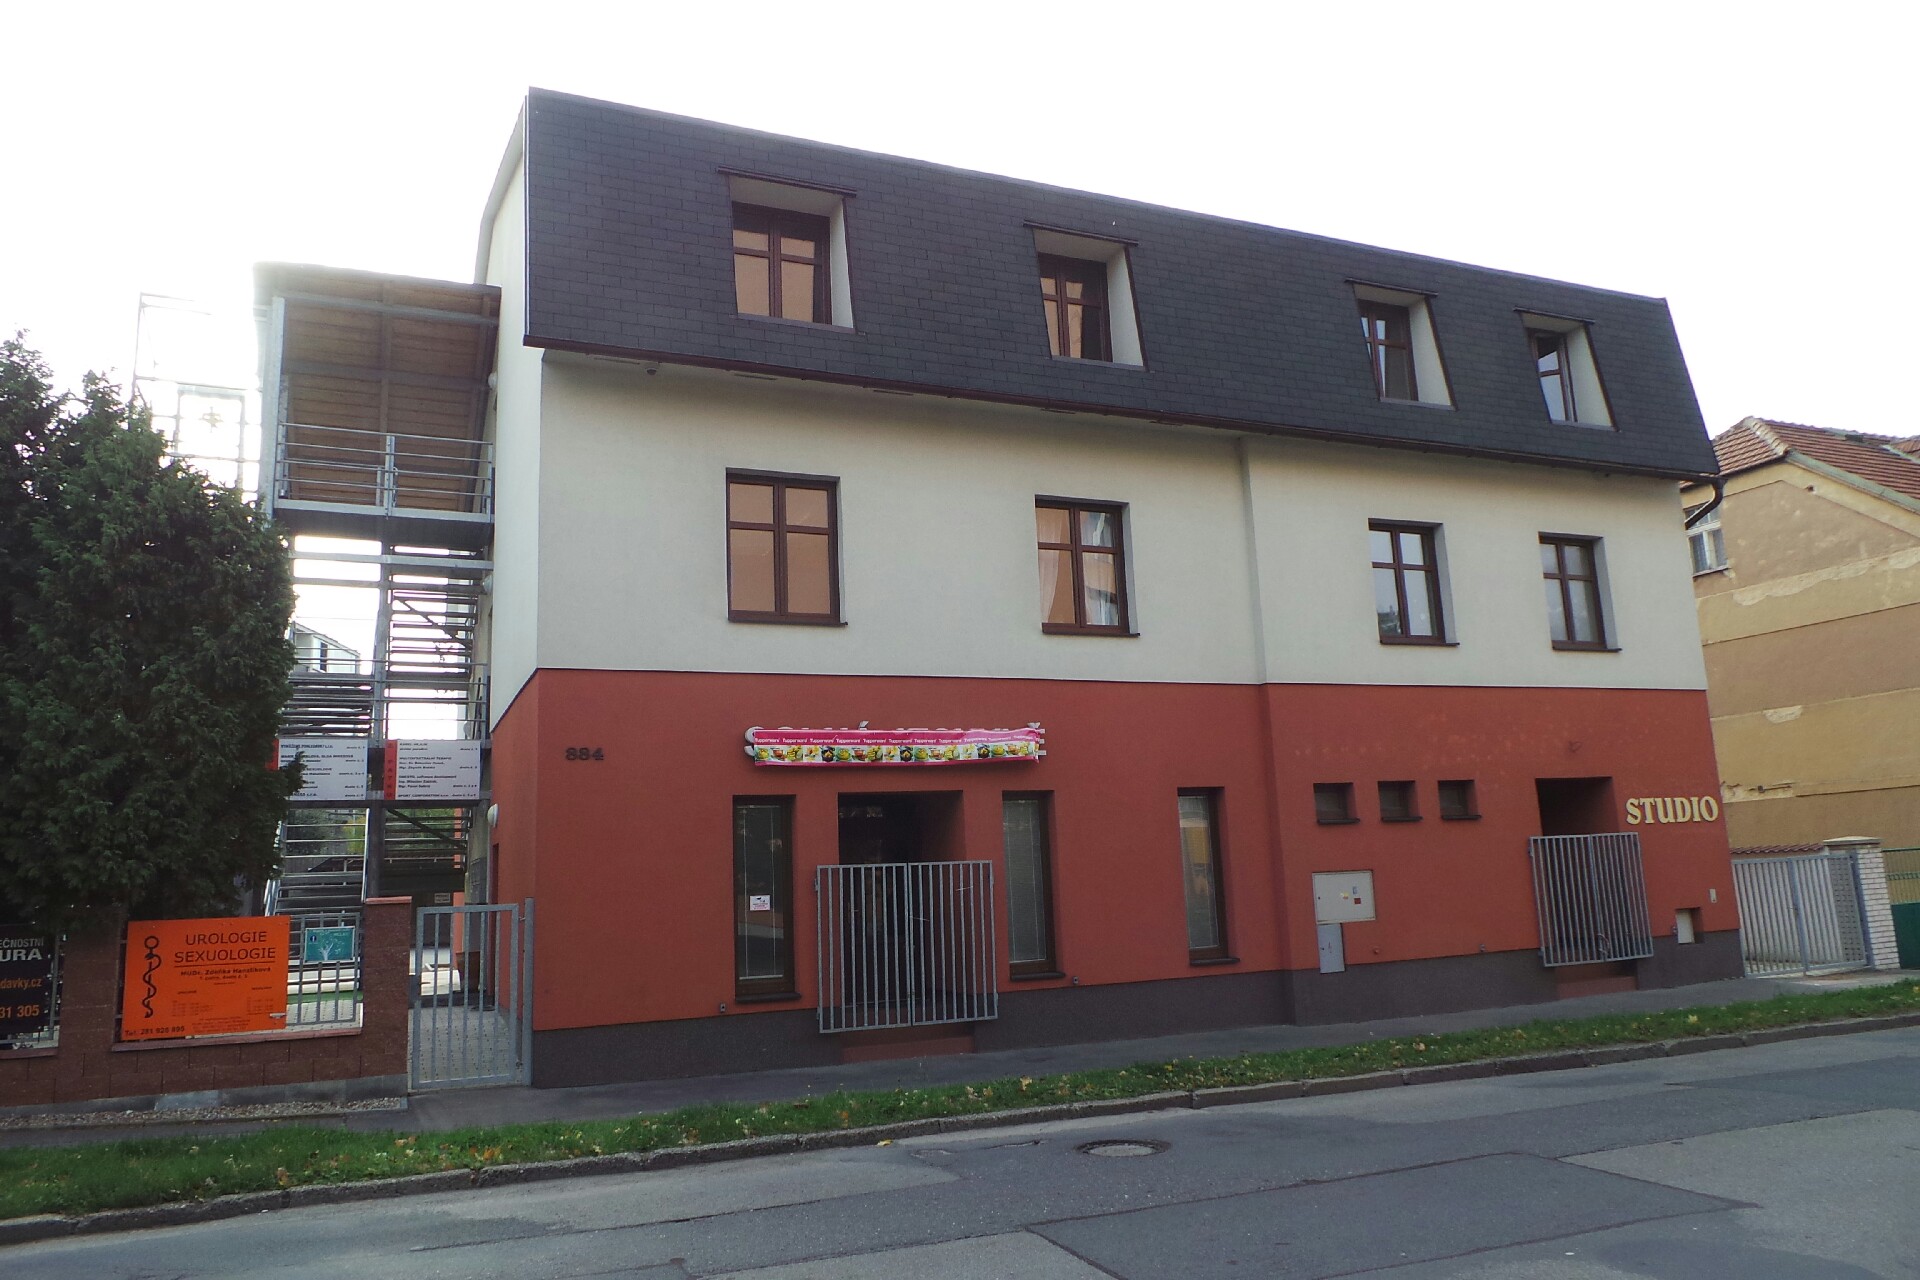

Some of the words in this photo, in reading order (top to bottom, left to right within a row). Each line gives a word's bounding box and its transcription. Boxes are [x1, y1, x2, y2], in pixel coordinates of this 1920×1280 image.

[566, 747, 604, 761] 884
[1625, 796, 1719, 825] STUDIO
[185, 931, 268, 946] UROLOGIE
[174, 947, 276, 963] SEXUOLOGIE
[17, 1005, 40, 1017] 305
